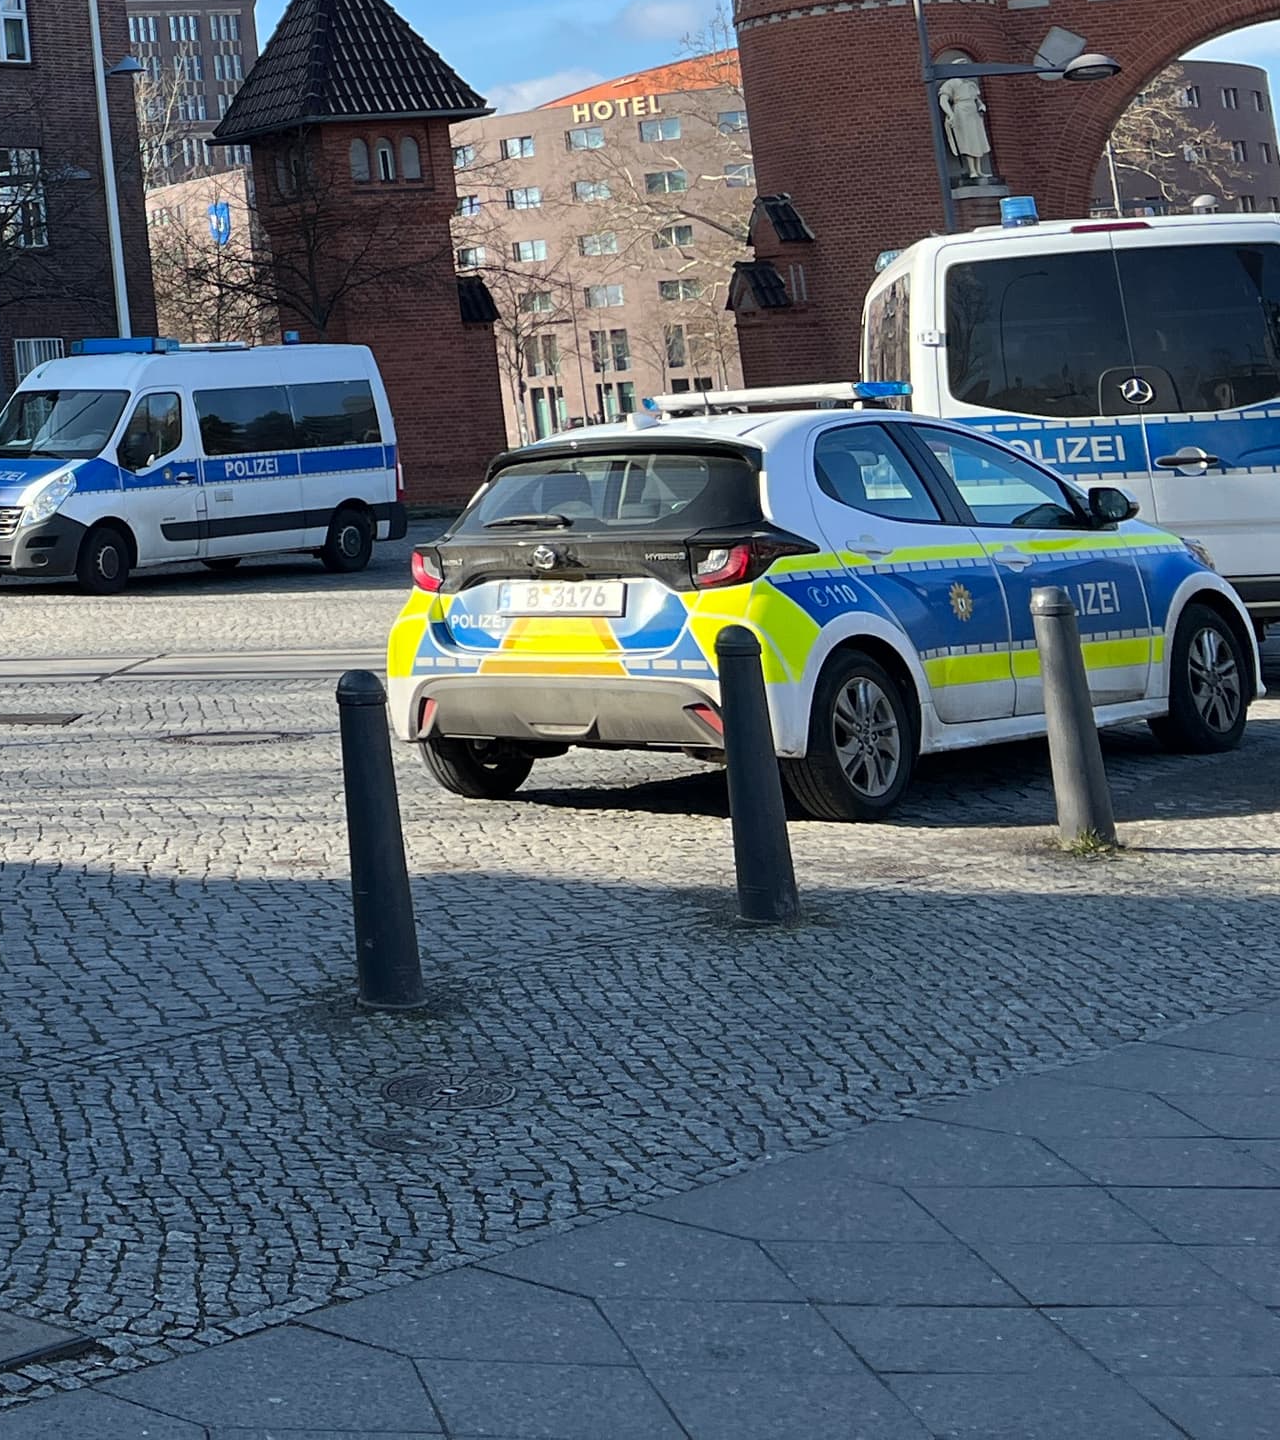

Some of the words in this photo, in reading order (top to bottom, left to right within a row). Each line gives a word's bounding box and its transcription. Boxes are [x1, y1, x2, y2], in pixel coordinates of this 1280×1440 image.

[573, 95, 662, 123] HOTEL
[1008, 435, 1126, 464] OLIZEI
[224, 458, 279, 478] POLIZEI
[552, 585, 607, 608] 3176
[825, 584, 858, 604] 110
[451, 614, 506, 629] POLIZEI
